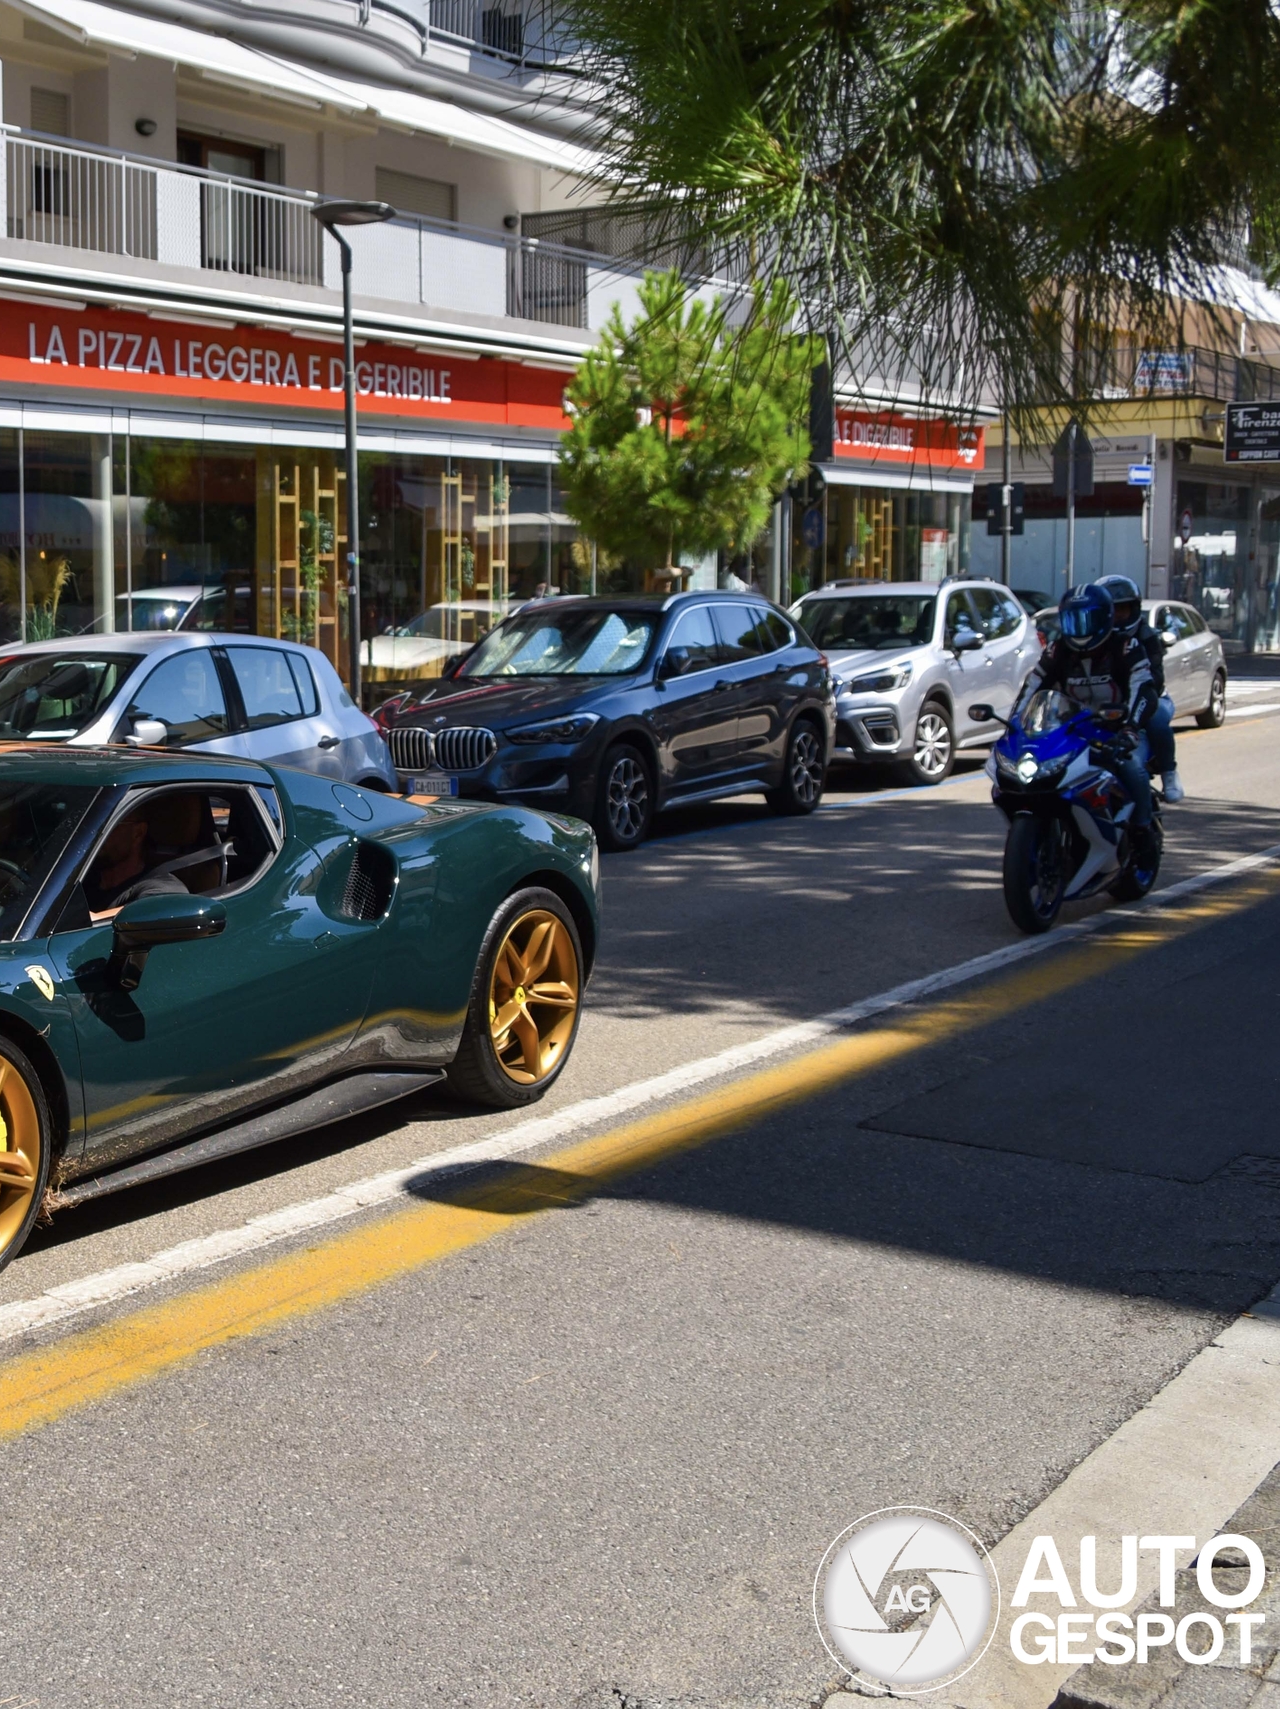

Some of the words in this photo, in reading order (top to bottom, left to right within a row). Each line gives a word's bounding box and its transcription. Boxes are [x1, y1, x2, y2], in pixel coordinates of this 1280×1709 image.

[29, 322, 68, 366] LA
[78, 327, 165, 375] PIZZA
[174, 339, 301, 389] LEGGERA
[308, 354, 322, 391] E
[329, 357, 452, 404] DGERIBILE
